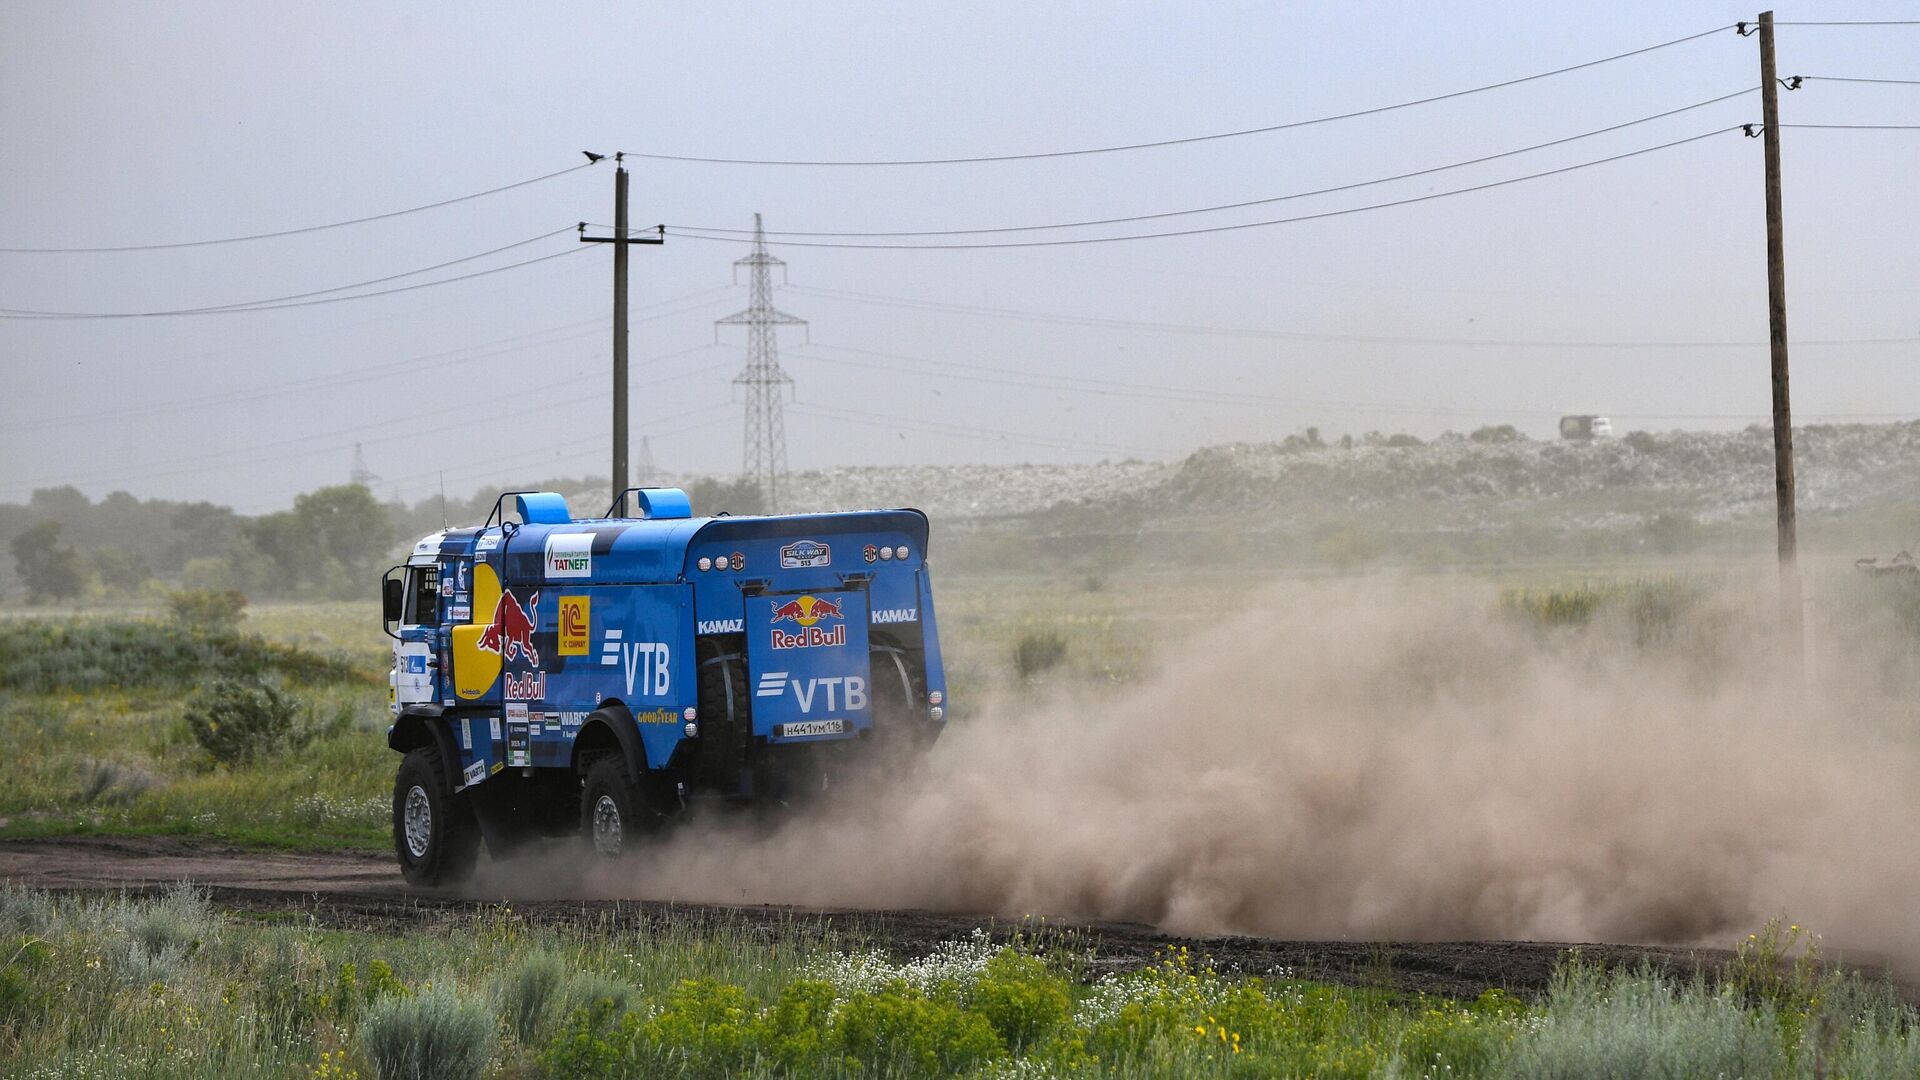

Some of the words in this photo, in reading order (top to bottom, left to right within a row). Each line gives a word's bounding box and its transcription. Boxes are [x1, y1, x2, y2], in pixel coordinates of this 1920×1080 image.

[785, 549, 805, 557] SILK
[807, 548, 825, 556] WAY
[554, 559, 589, 571] TATNEFT
[872, 608, 917, 624] KAMAZ
[698, 619, 744, 634] KAMAZ
[771, 626, 807, 649] Red
[809, 624, 846, 647] Bull
[623, 642, 670, 696] VTB
[504, 671, 526, 700] Red
[526, 670, 545, 700] Bull
[791, 676, 867, 713] VTB
